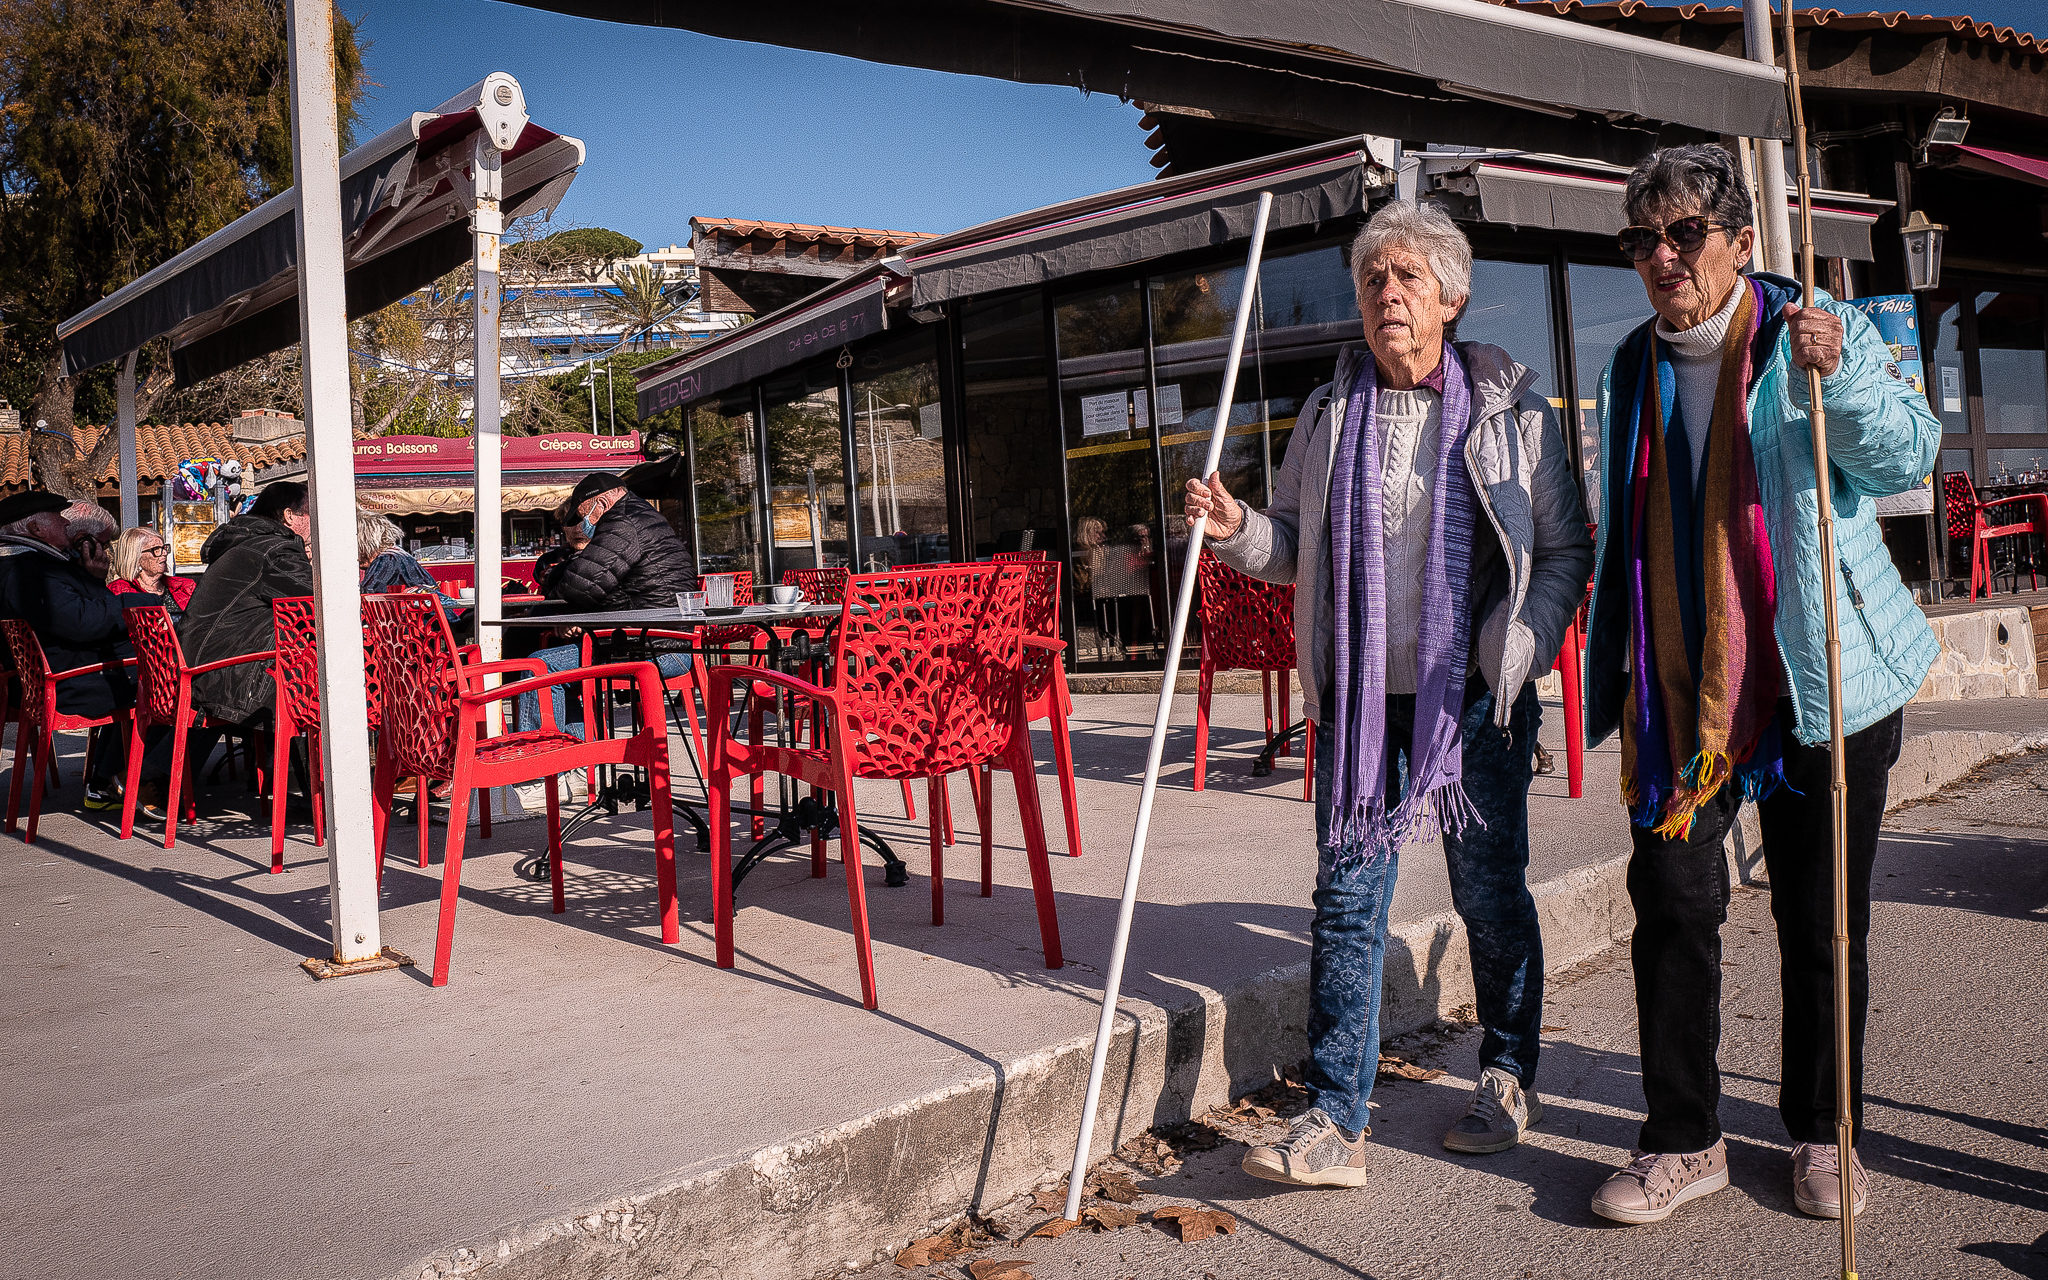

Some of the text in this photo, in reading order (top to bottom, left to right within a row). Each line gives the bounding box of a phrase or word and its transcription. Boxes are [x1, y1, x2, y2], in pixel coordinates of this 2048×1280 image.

[1858, 298, 1914, 315] KTAILS
[788, 338, 801, 352] 04
[803, 331, 818, 345] 94
[821, 324, 836, 339] 03
[851, 312, 865, 327] 77
[352, 442, 438, 455] urros Boissons
[539, 438, 635, 453] Crêpes Gaufres
[360, 493, 396, 502] Crêpes
[359, 502, 399, 510] Gaufres
